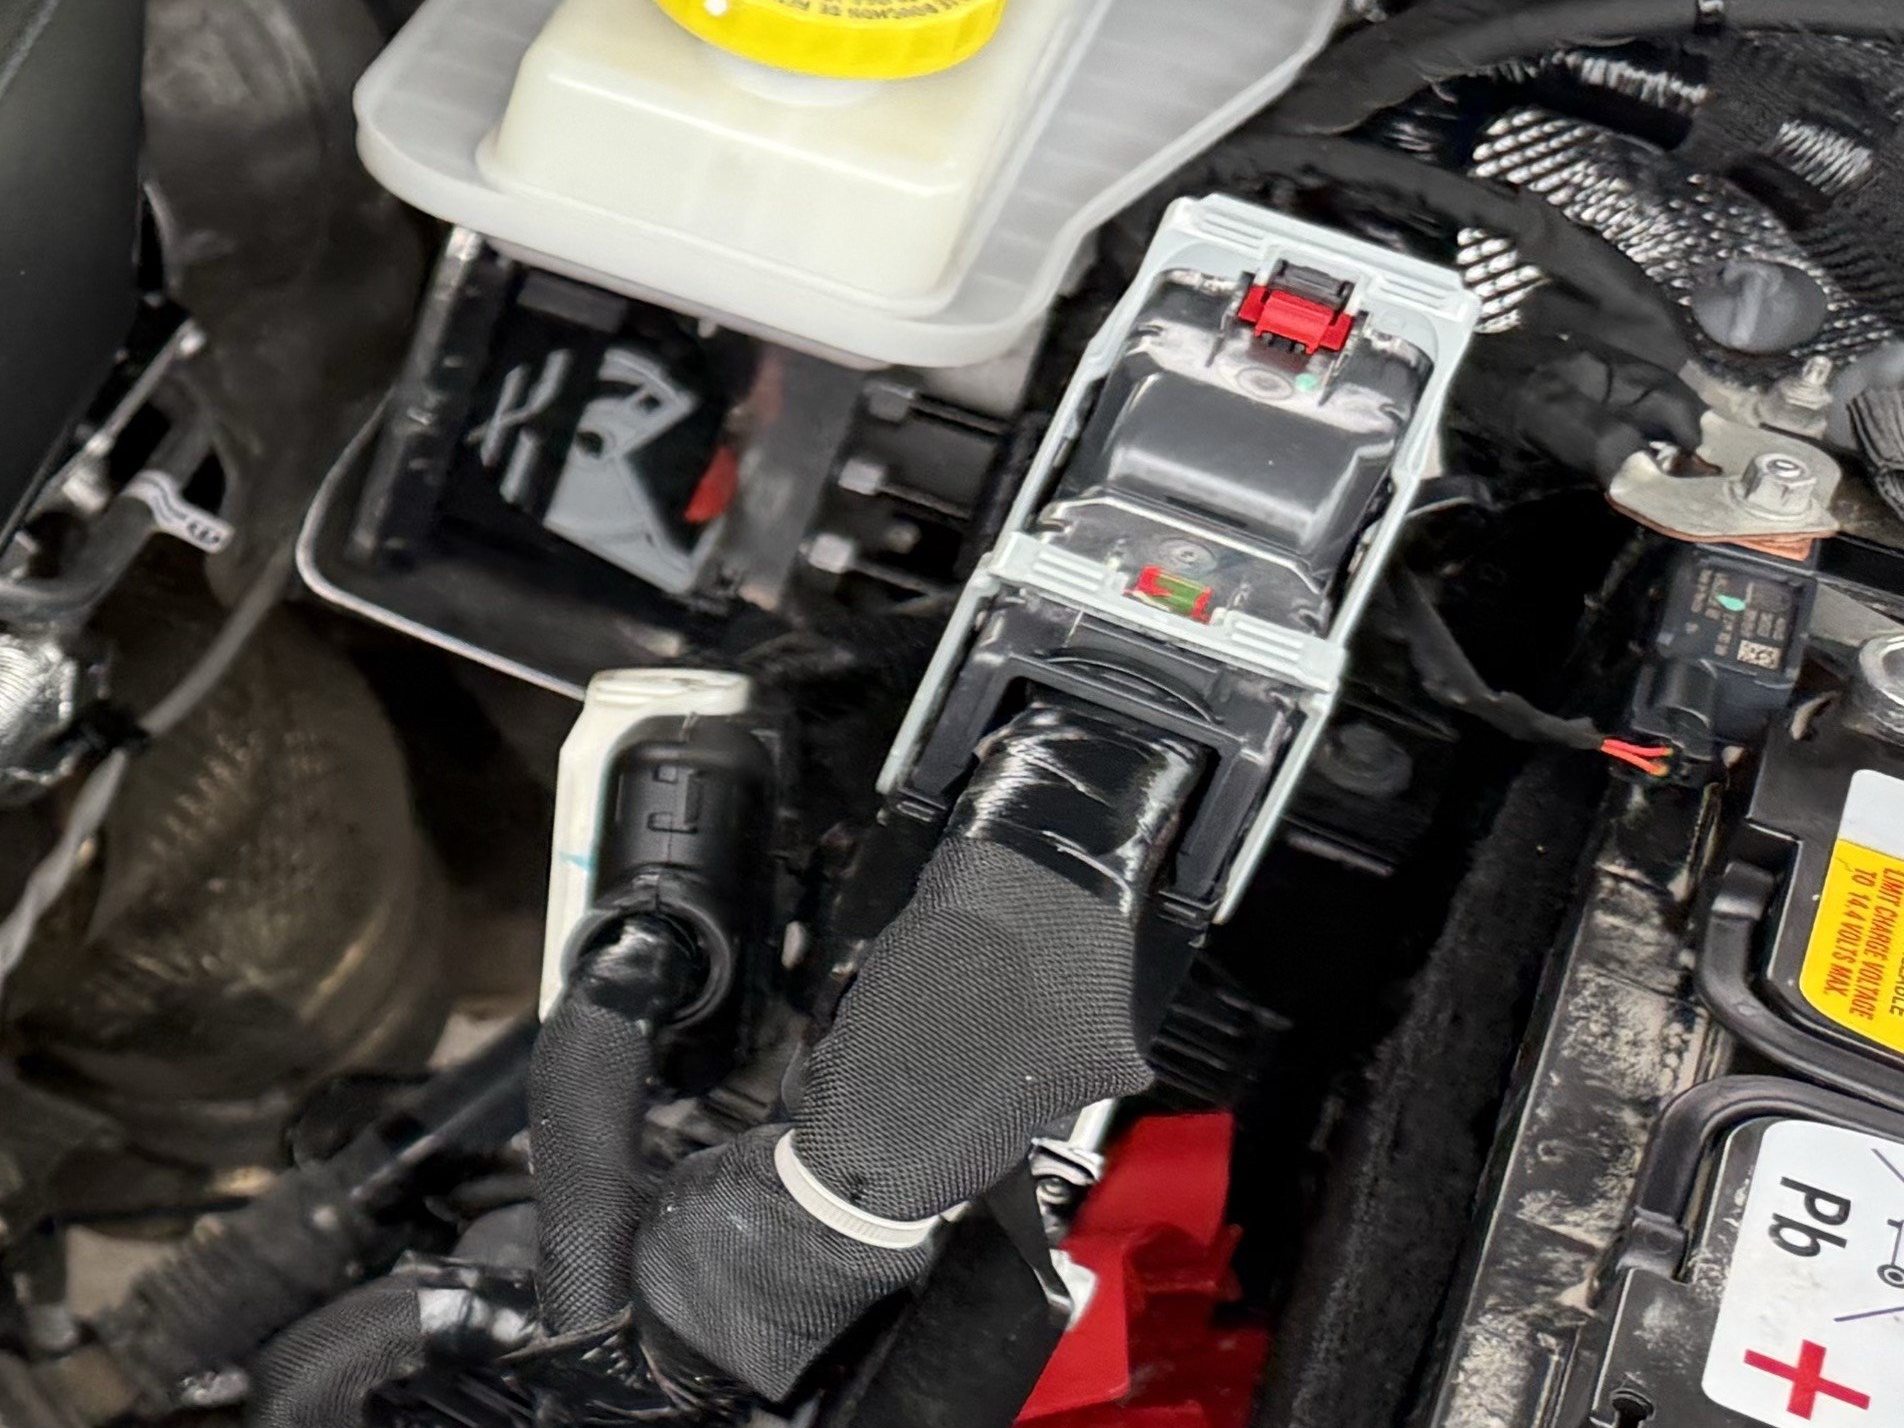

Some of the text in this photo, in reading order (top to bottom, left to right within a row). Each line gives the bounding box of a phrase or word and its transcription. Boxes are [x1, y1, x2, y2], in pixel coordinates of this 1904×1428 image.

[1876, 867, 1904, 905] LIMIT
[1822, 868, 1878, 998] TO 14.4 VOLTS MAX.
[1863, 905, 1900, 961] CHARGE
[1849, 961, 1885, 1020] VOLTAGE
[1766, 1176, 1852, 1258] Pb
